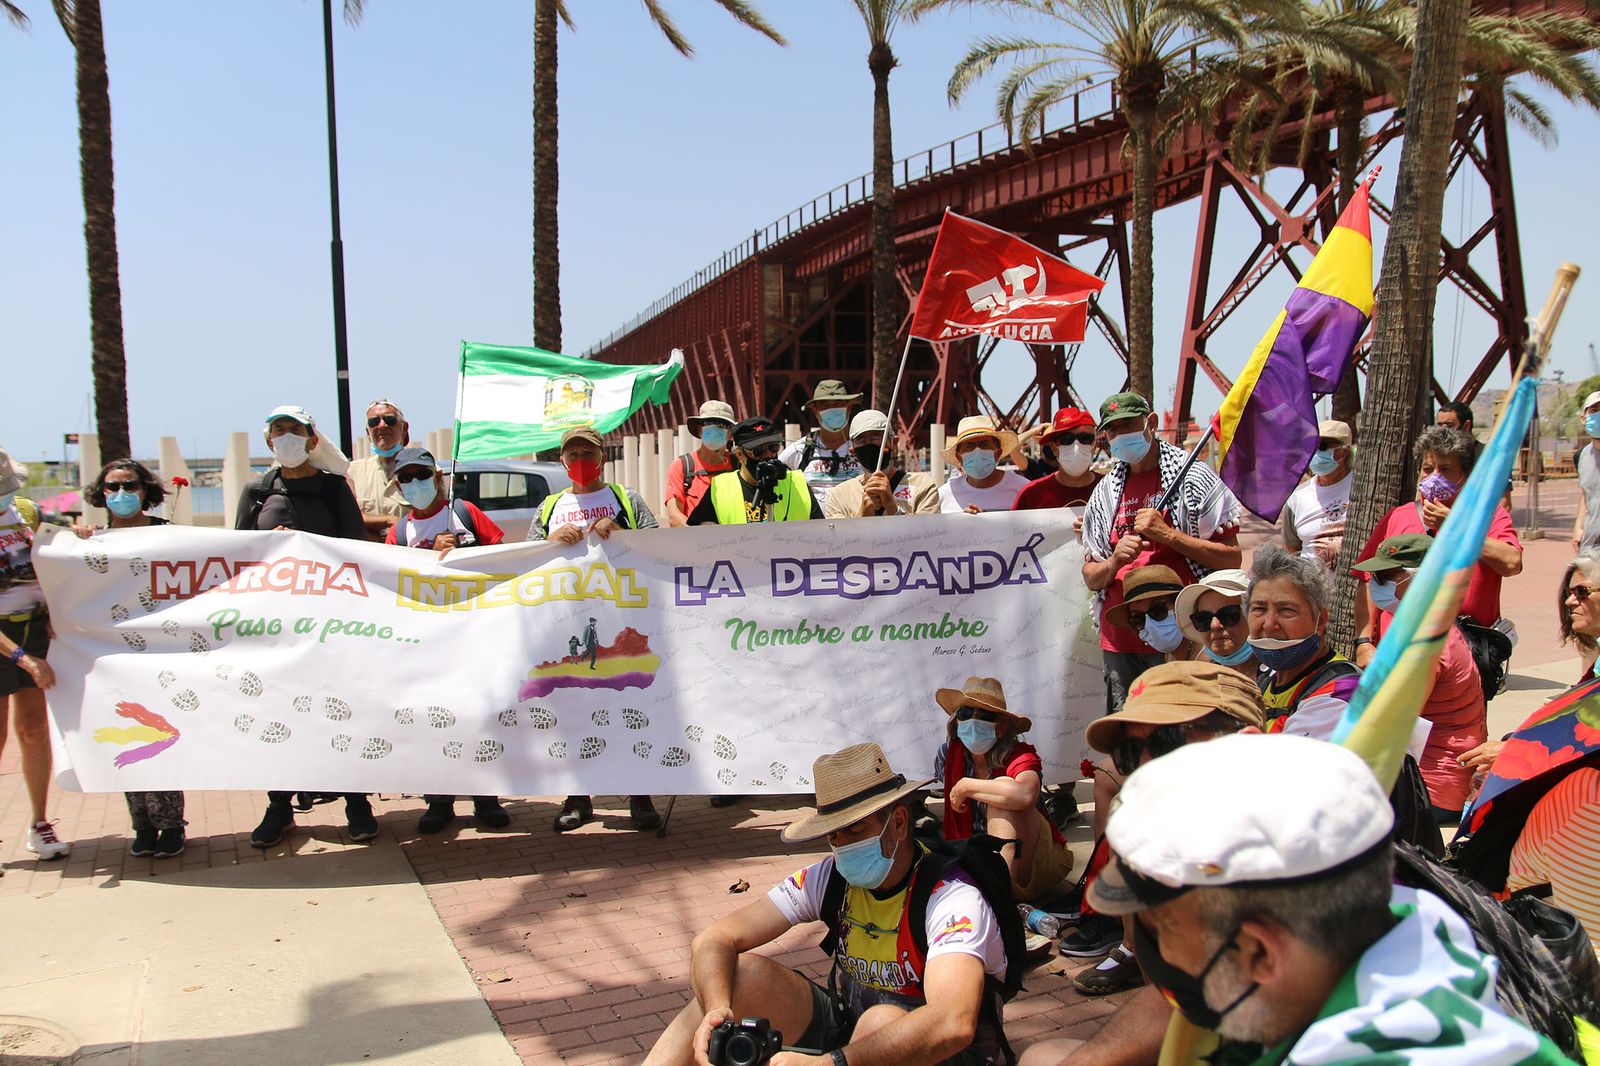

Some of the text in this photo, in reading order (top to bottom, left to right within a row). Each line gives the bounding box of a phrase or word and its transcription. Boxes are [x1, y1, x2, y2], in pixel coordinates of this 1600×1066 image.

[939, 324, 1054, 341] ANALUCIA
[555, 514, 566, 525] LA
[151, 556, 369, 600] MARCHA
[396, 562, 649, 612] INTEGRAL
[675, 560, 746, 607] LA
[770, 532, 1049, 600] DESBANDÁ
[206, 608, 420, 644] Paso a paso...
[725, 617, 845, 652] Nombre
[851, 624, 874, 642] a
[880, 612, 989, 641] nombre
[932, 644, 991, 656] Marcos G. Sedano
[837, 951, 920, 987] ESBANDÁ
